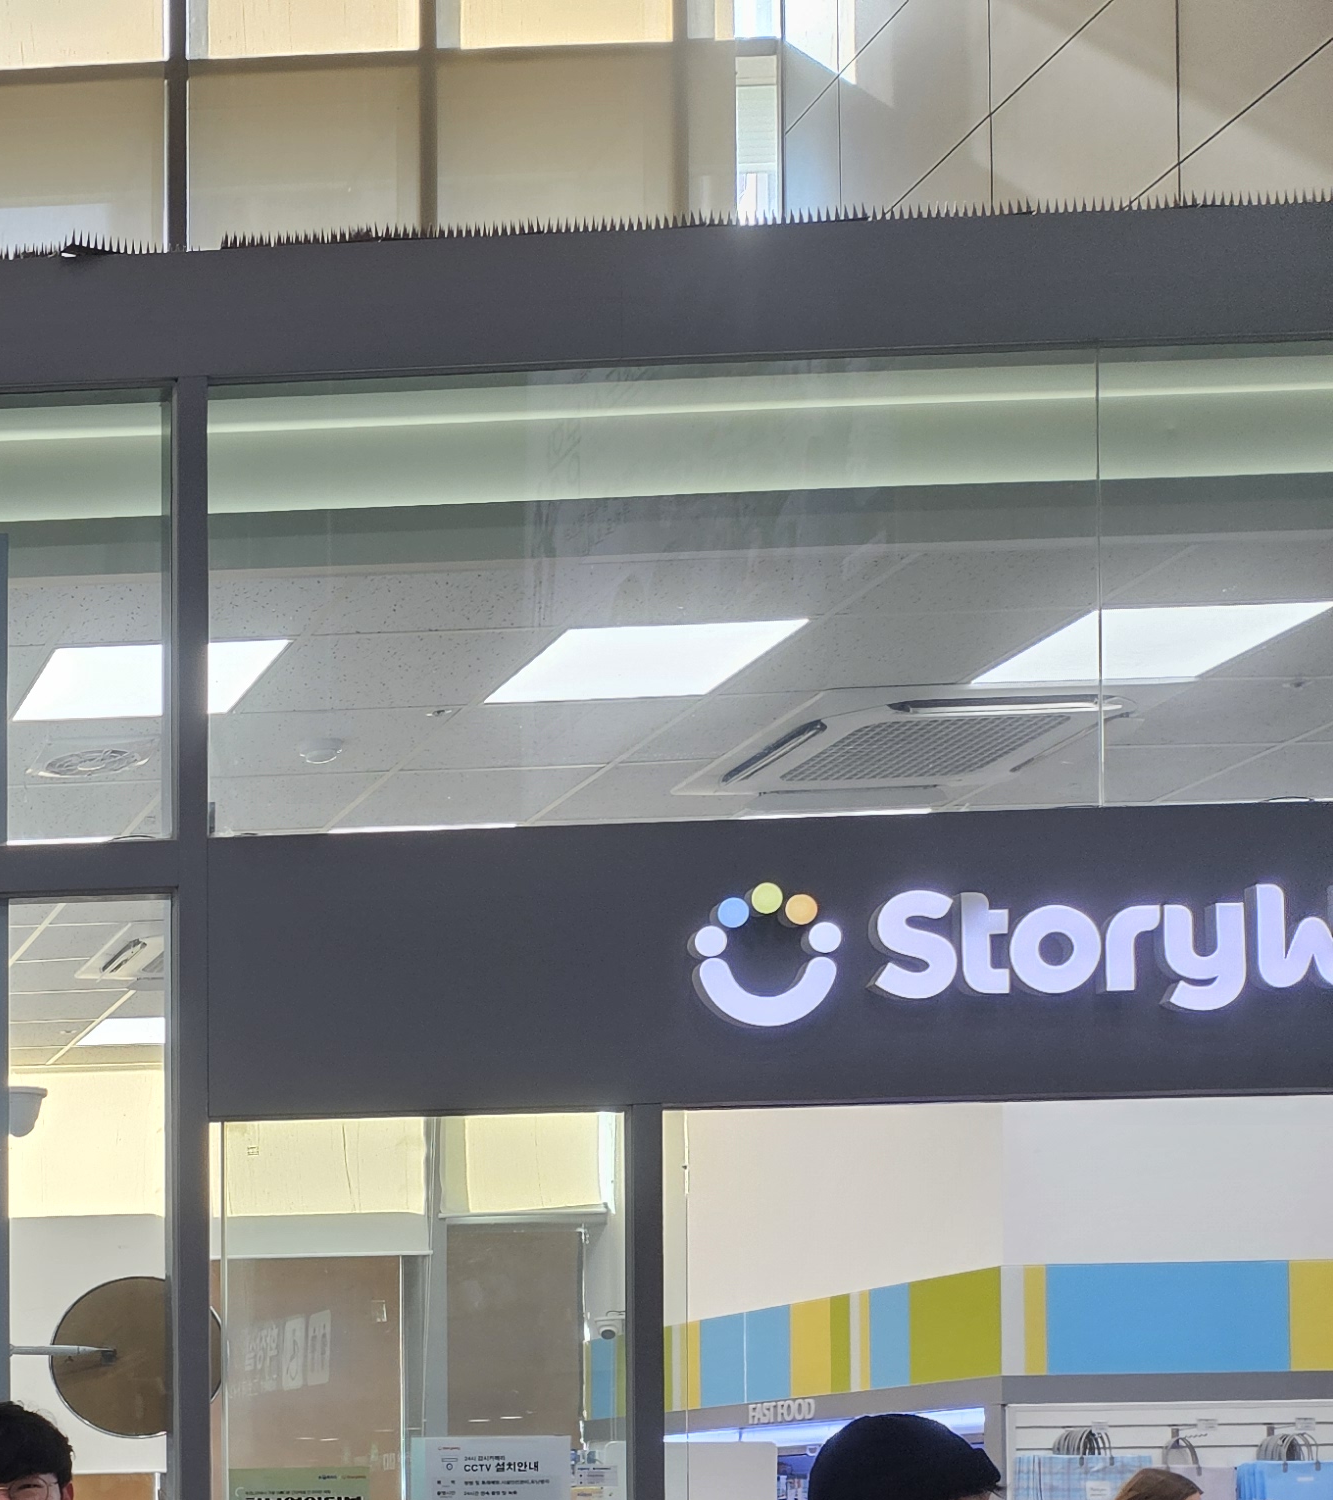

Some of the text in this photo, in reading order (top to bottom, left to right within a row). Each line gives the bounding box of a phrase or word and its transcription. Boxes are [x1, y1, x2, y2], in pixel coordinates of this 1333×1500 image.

[748, 1398, 815, 1424] FAST FOOD
[464, 1461, 539, 1472] CCTV 설치안내
